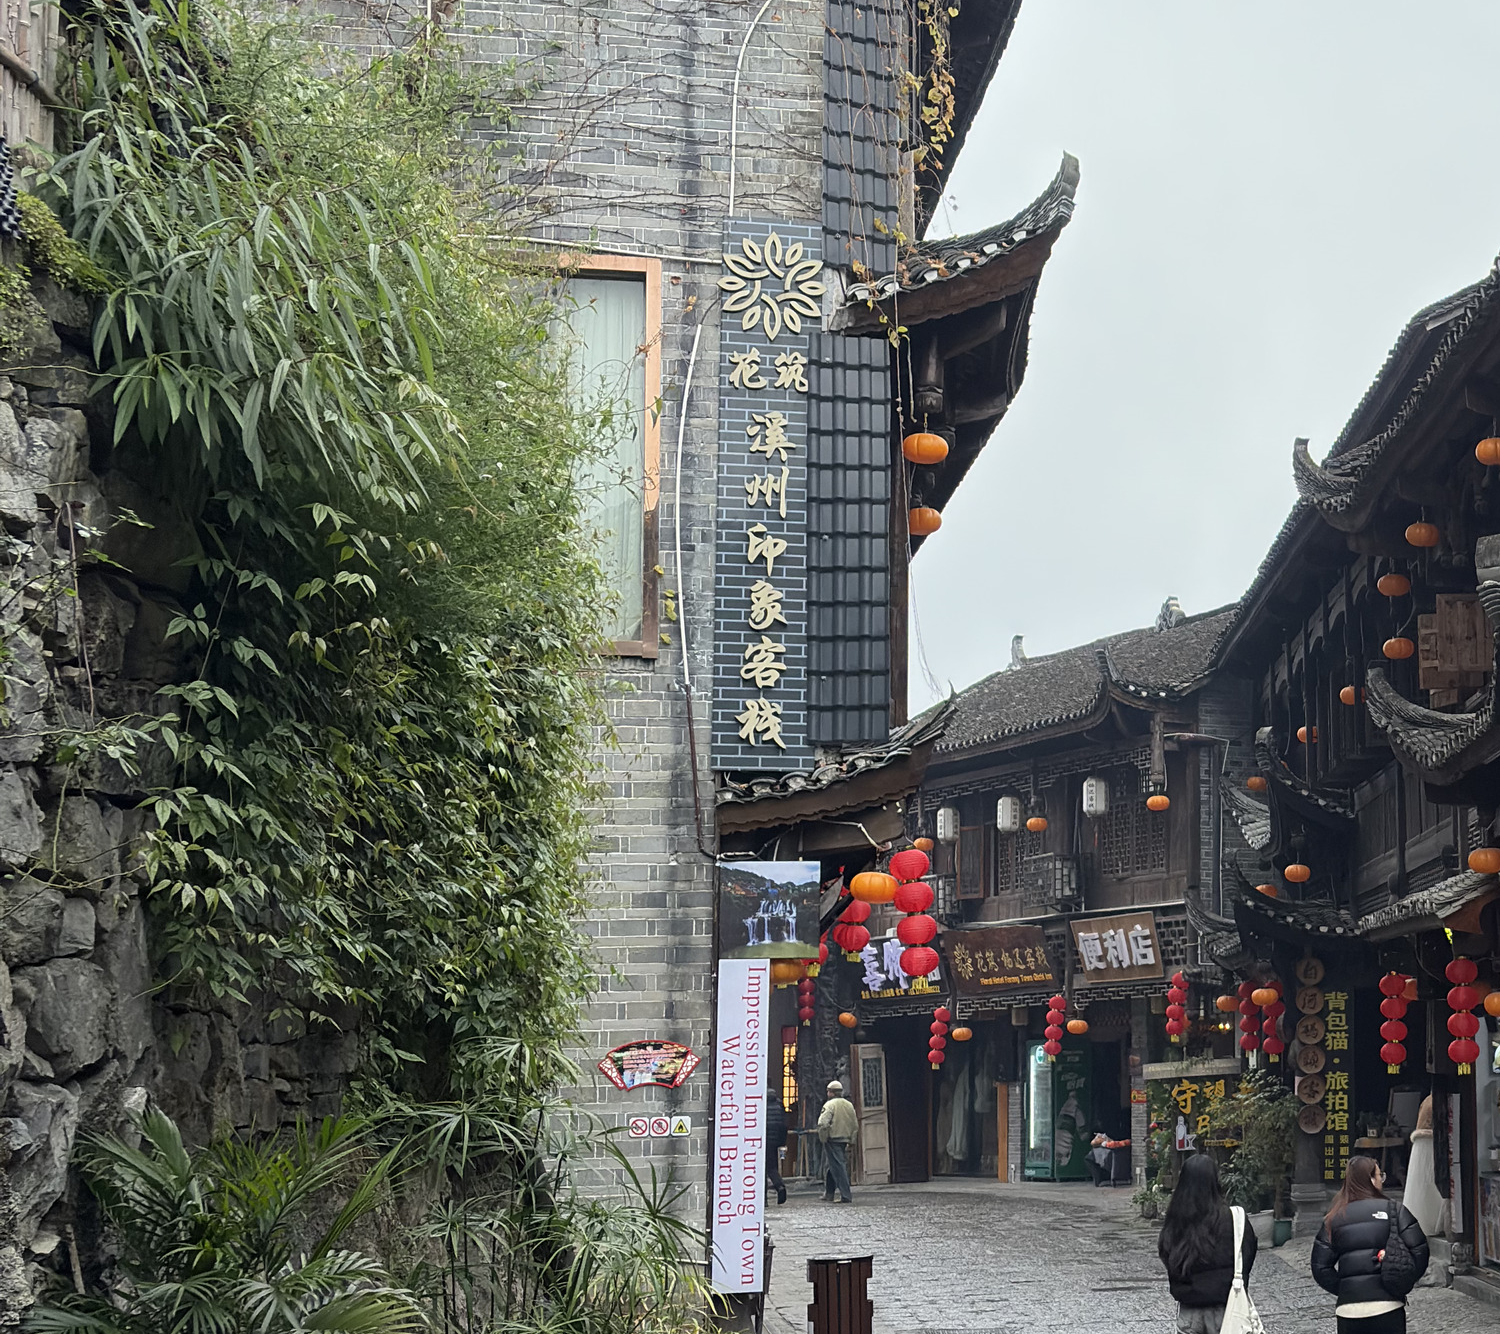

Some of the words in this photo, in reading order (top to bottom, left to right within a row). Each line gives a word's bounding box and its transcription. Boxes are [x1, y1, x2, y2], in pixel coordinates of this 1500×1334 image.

[727, 347, 809, 393] 花筑
[735, 411, 797, 751] 溪州印象客栈
[1078, 924, 1156, 971] 便利店
[741, 965, 767, 1087] Impression
[719, 1035, 741, 1139] Waterfall
[743, 1095, 763, 1129] Inn
[717, 1146, 738, 1225] Branch
[737, 1138, 762, 1216] Furong
[741, 1222, 760, 1286] Town
